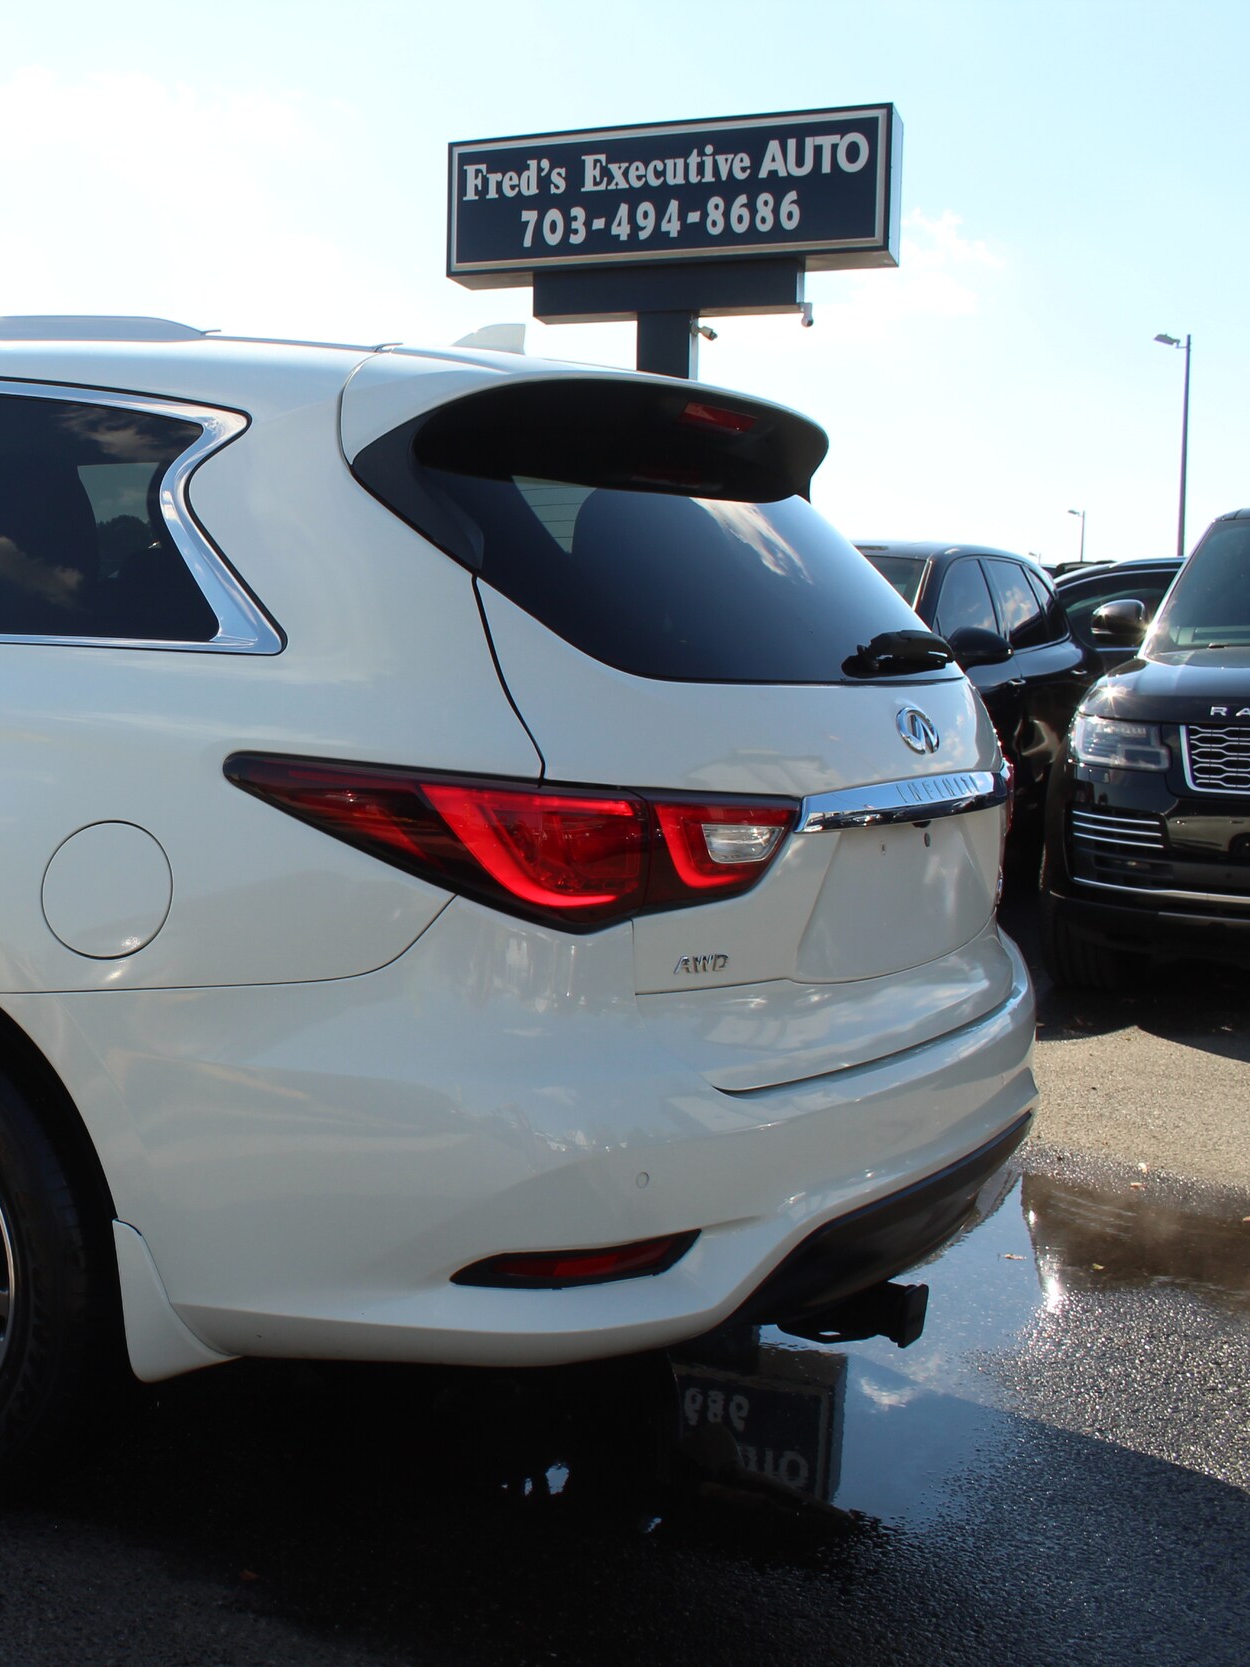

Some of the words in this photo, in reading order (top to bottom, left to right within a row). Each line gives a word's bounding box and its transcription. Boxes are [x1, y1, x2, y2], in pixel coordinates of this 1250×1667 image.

[462, 158, 566, 201] Fred's
[580, 144, 751, 192] Executive
[758, 132, 869, 179] AUTO
[520, 190, 800, 248] 703-494-8686
[895, 774, 980, 804] INFINITI
[673, 953, 729, 975] AWD
